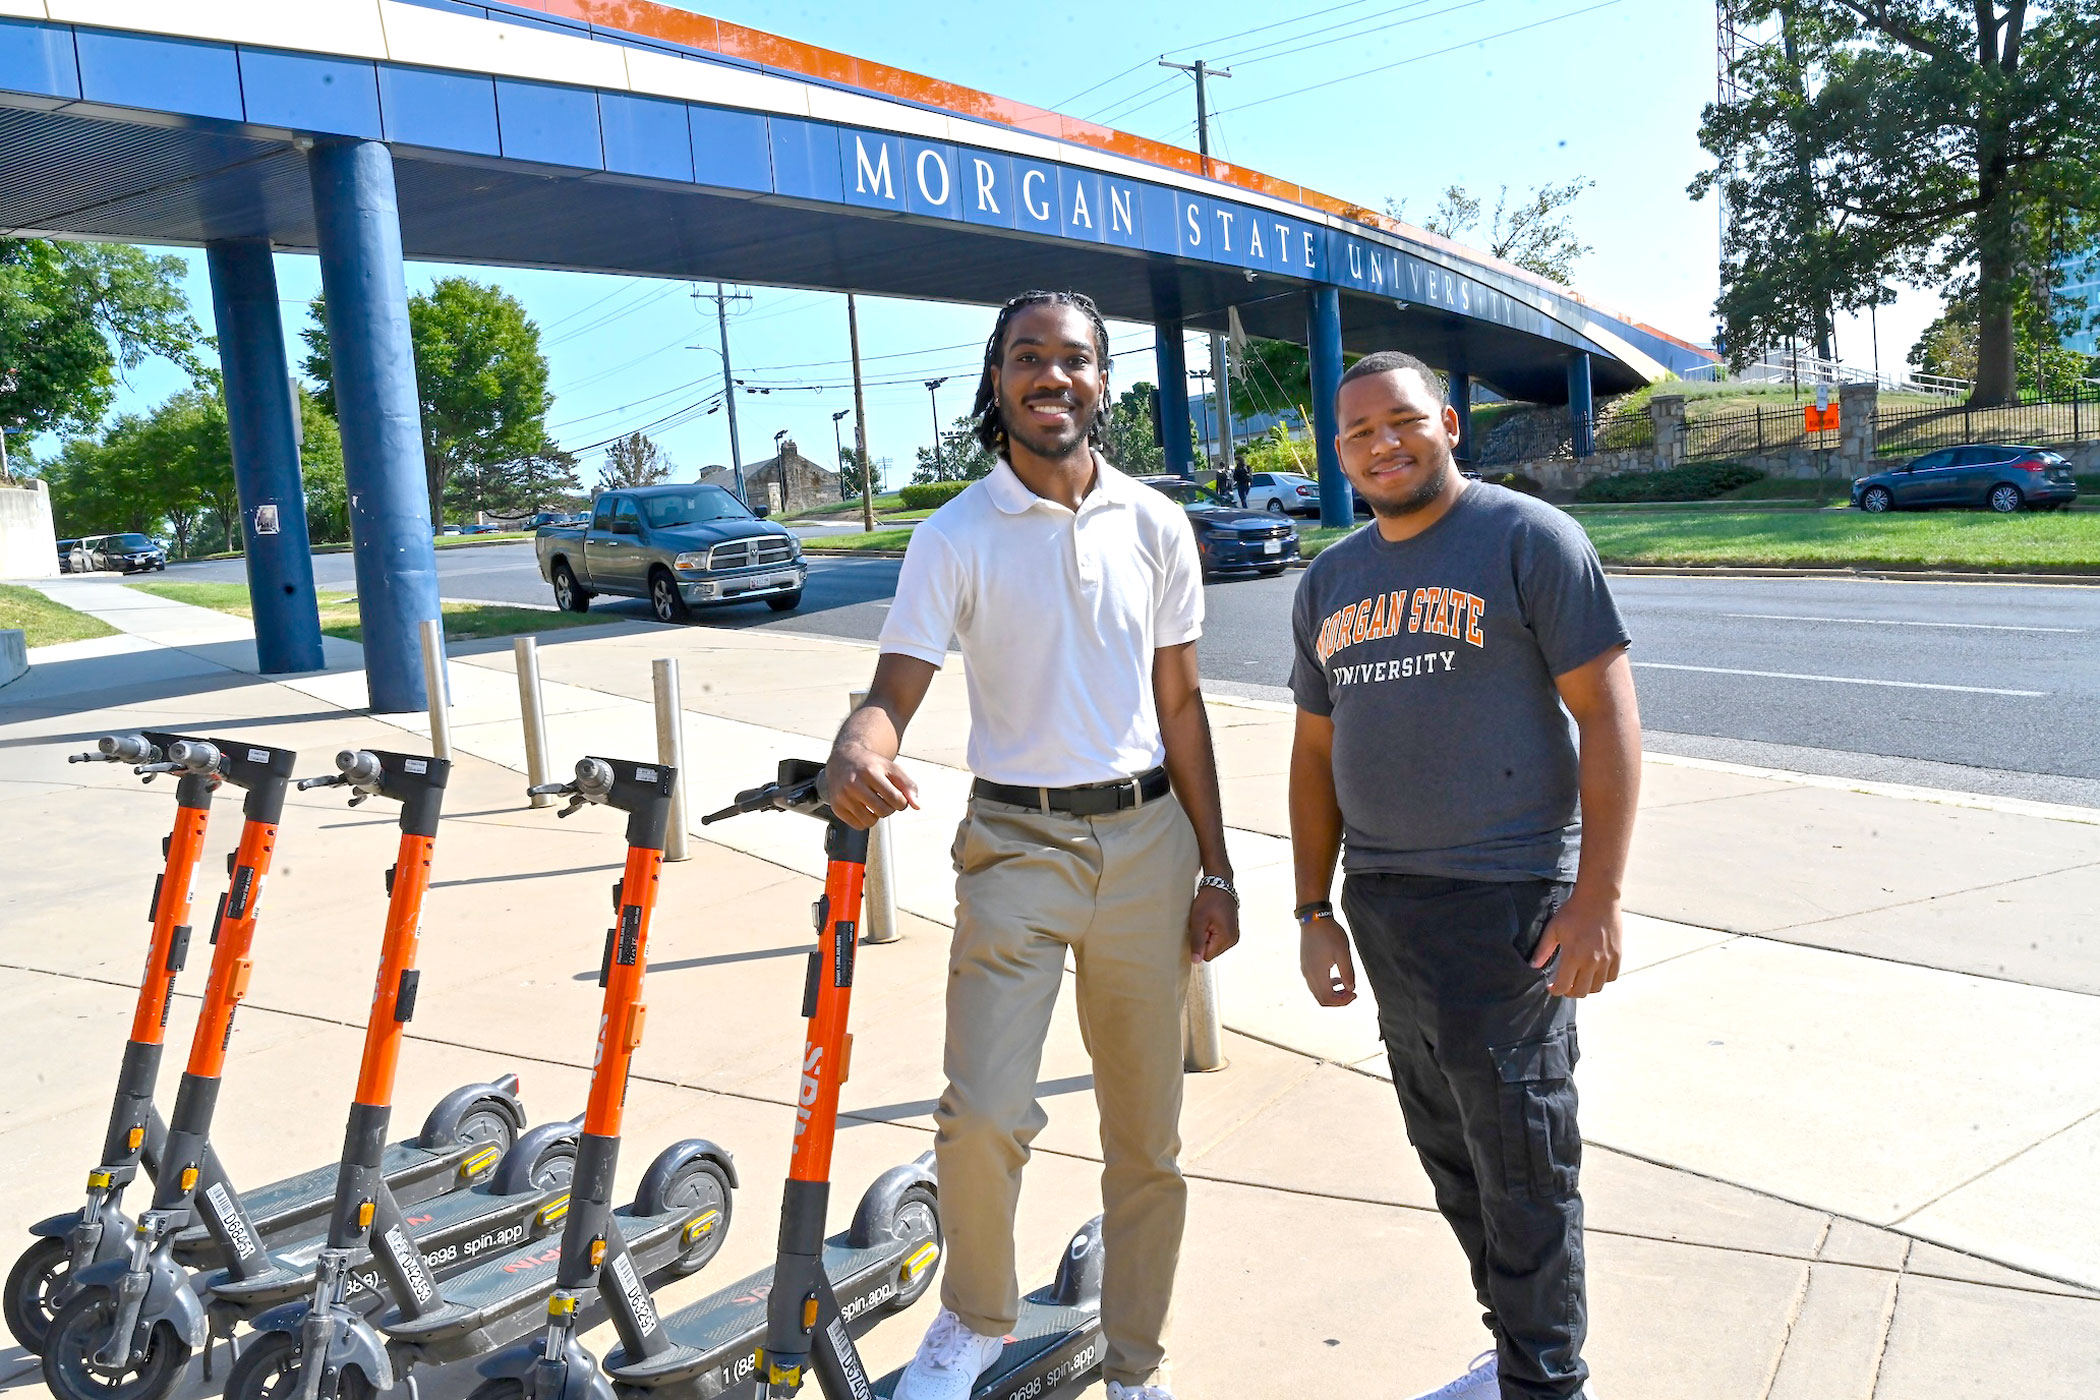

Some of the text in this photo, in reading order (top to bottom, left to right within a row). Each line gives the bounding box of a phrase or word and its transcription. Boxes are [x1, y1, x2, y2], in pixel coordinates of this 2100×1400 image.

[855, 135, 1512, 324] MORGAN STATE UNIVERSITY
[1315, 586, 1485, 667] MORGAN STATE
[1332, 650, 1457, 686] UNIVERSITY
[223, 1213, 254, 1258] D68451
[463, 1224, 523, 1256] spin.app
[628, 1285, 655, 1334] D63291
[723, 1367, 730, 1385] 1
[840, 1284, 891, 1321] spin.app
[1046, 1345, 1095, 1388] spin.app
